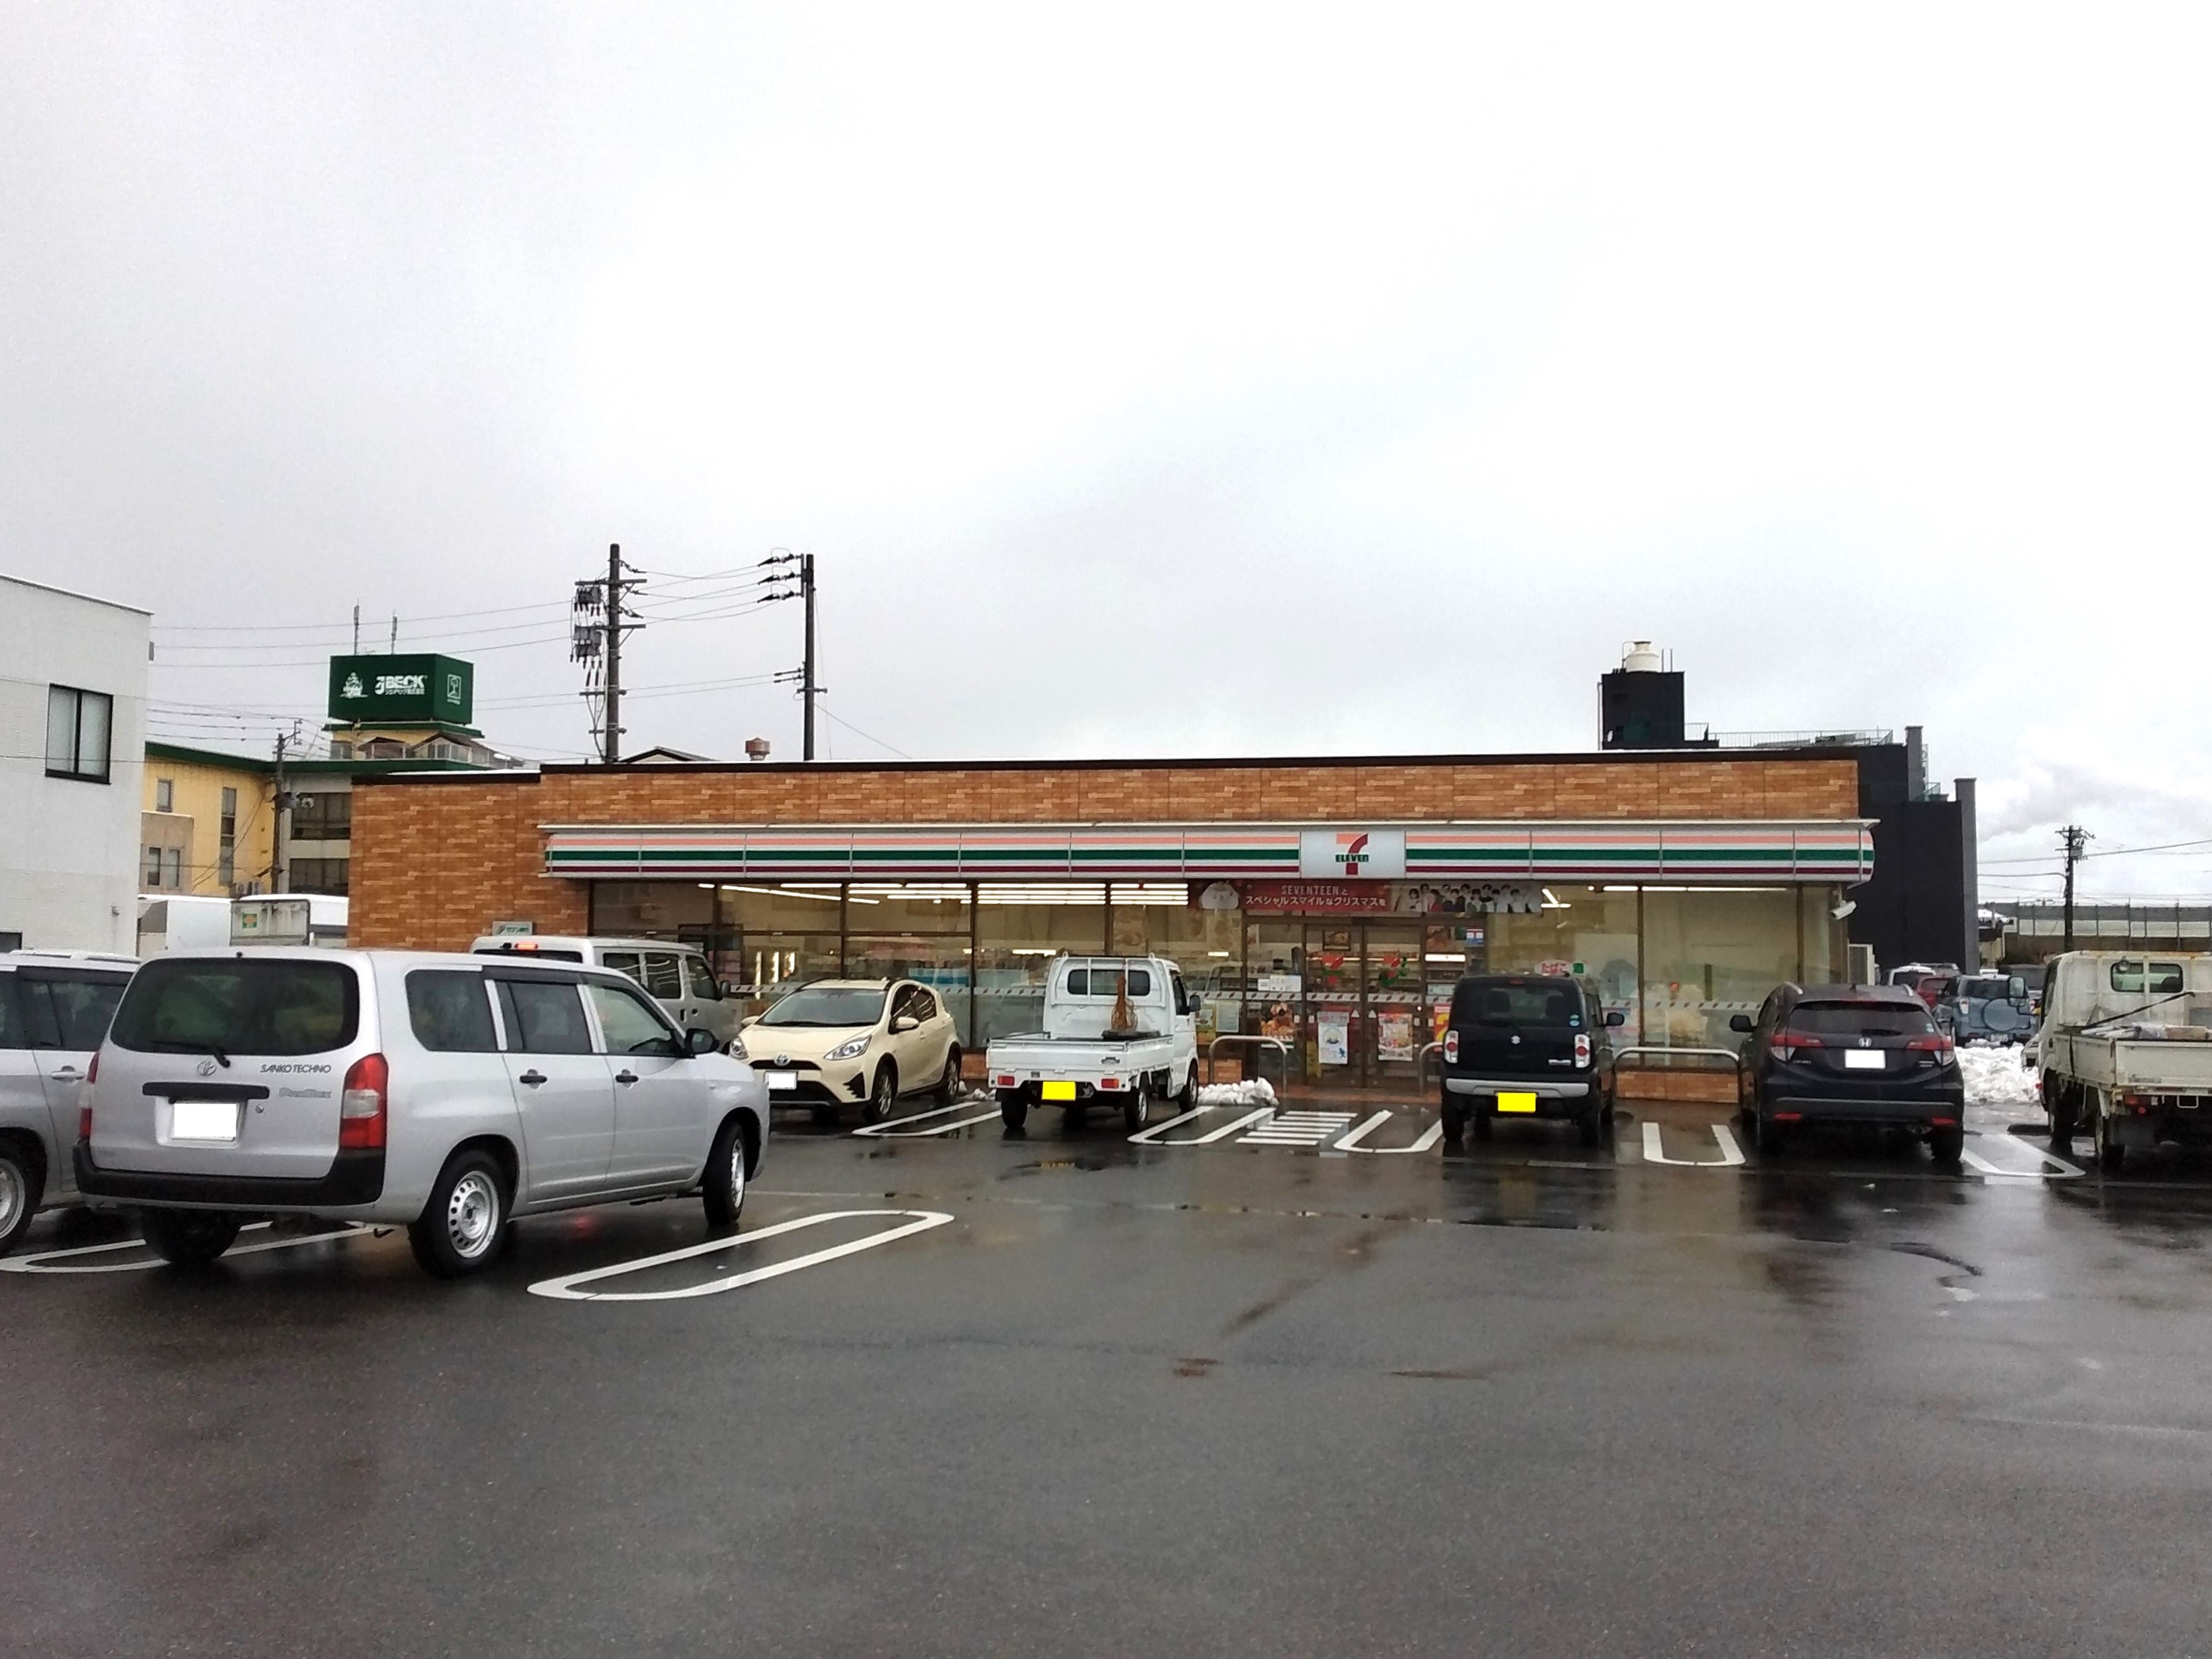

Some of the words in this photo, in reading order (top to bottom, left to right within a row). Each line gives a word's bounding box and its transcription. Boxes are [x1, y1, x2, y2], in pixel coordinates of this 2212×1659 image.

[1246, 896, 1386, 907] スペシャルスマイルなクリスマスを
